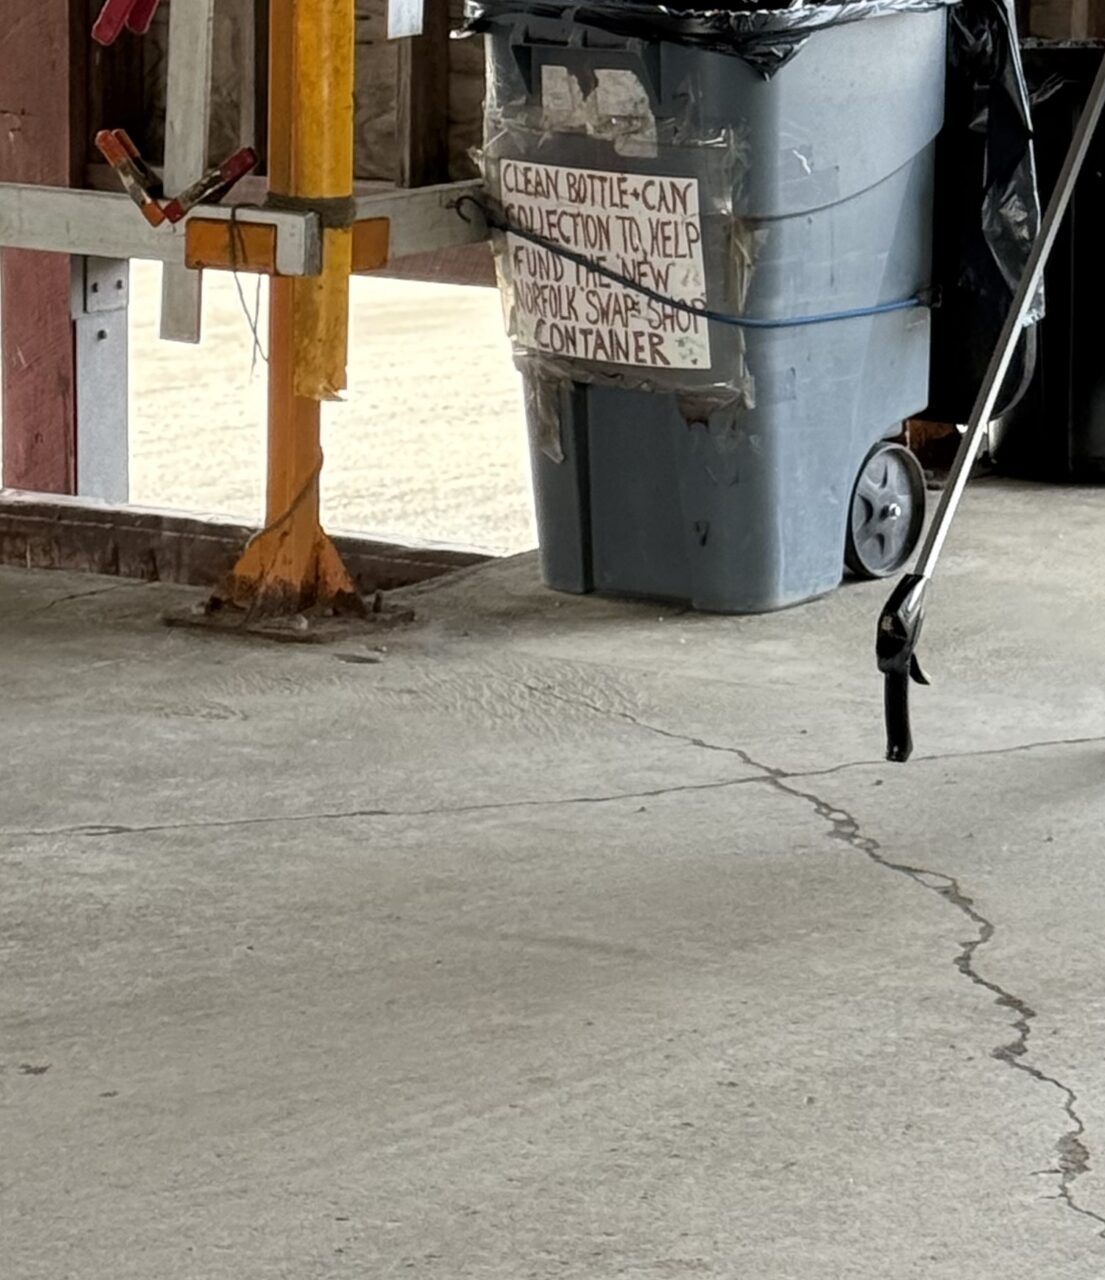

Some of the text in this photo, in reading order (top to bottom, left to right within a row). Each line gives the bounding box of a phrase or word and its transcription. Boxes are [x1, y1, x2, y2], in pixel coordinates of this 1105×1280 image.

[503, 162, 560, 202] CLEAN
[615, 215, 641, 254] TO
[648, 217, 701, 259] HELP
[512, 245, 565, 283] FUND
[513, 279, 580, 323] NORFOLK
[646, 296, 708, 335] SHOP
[534, 319, 672, 367] CONTAINER
